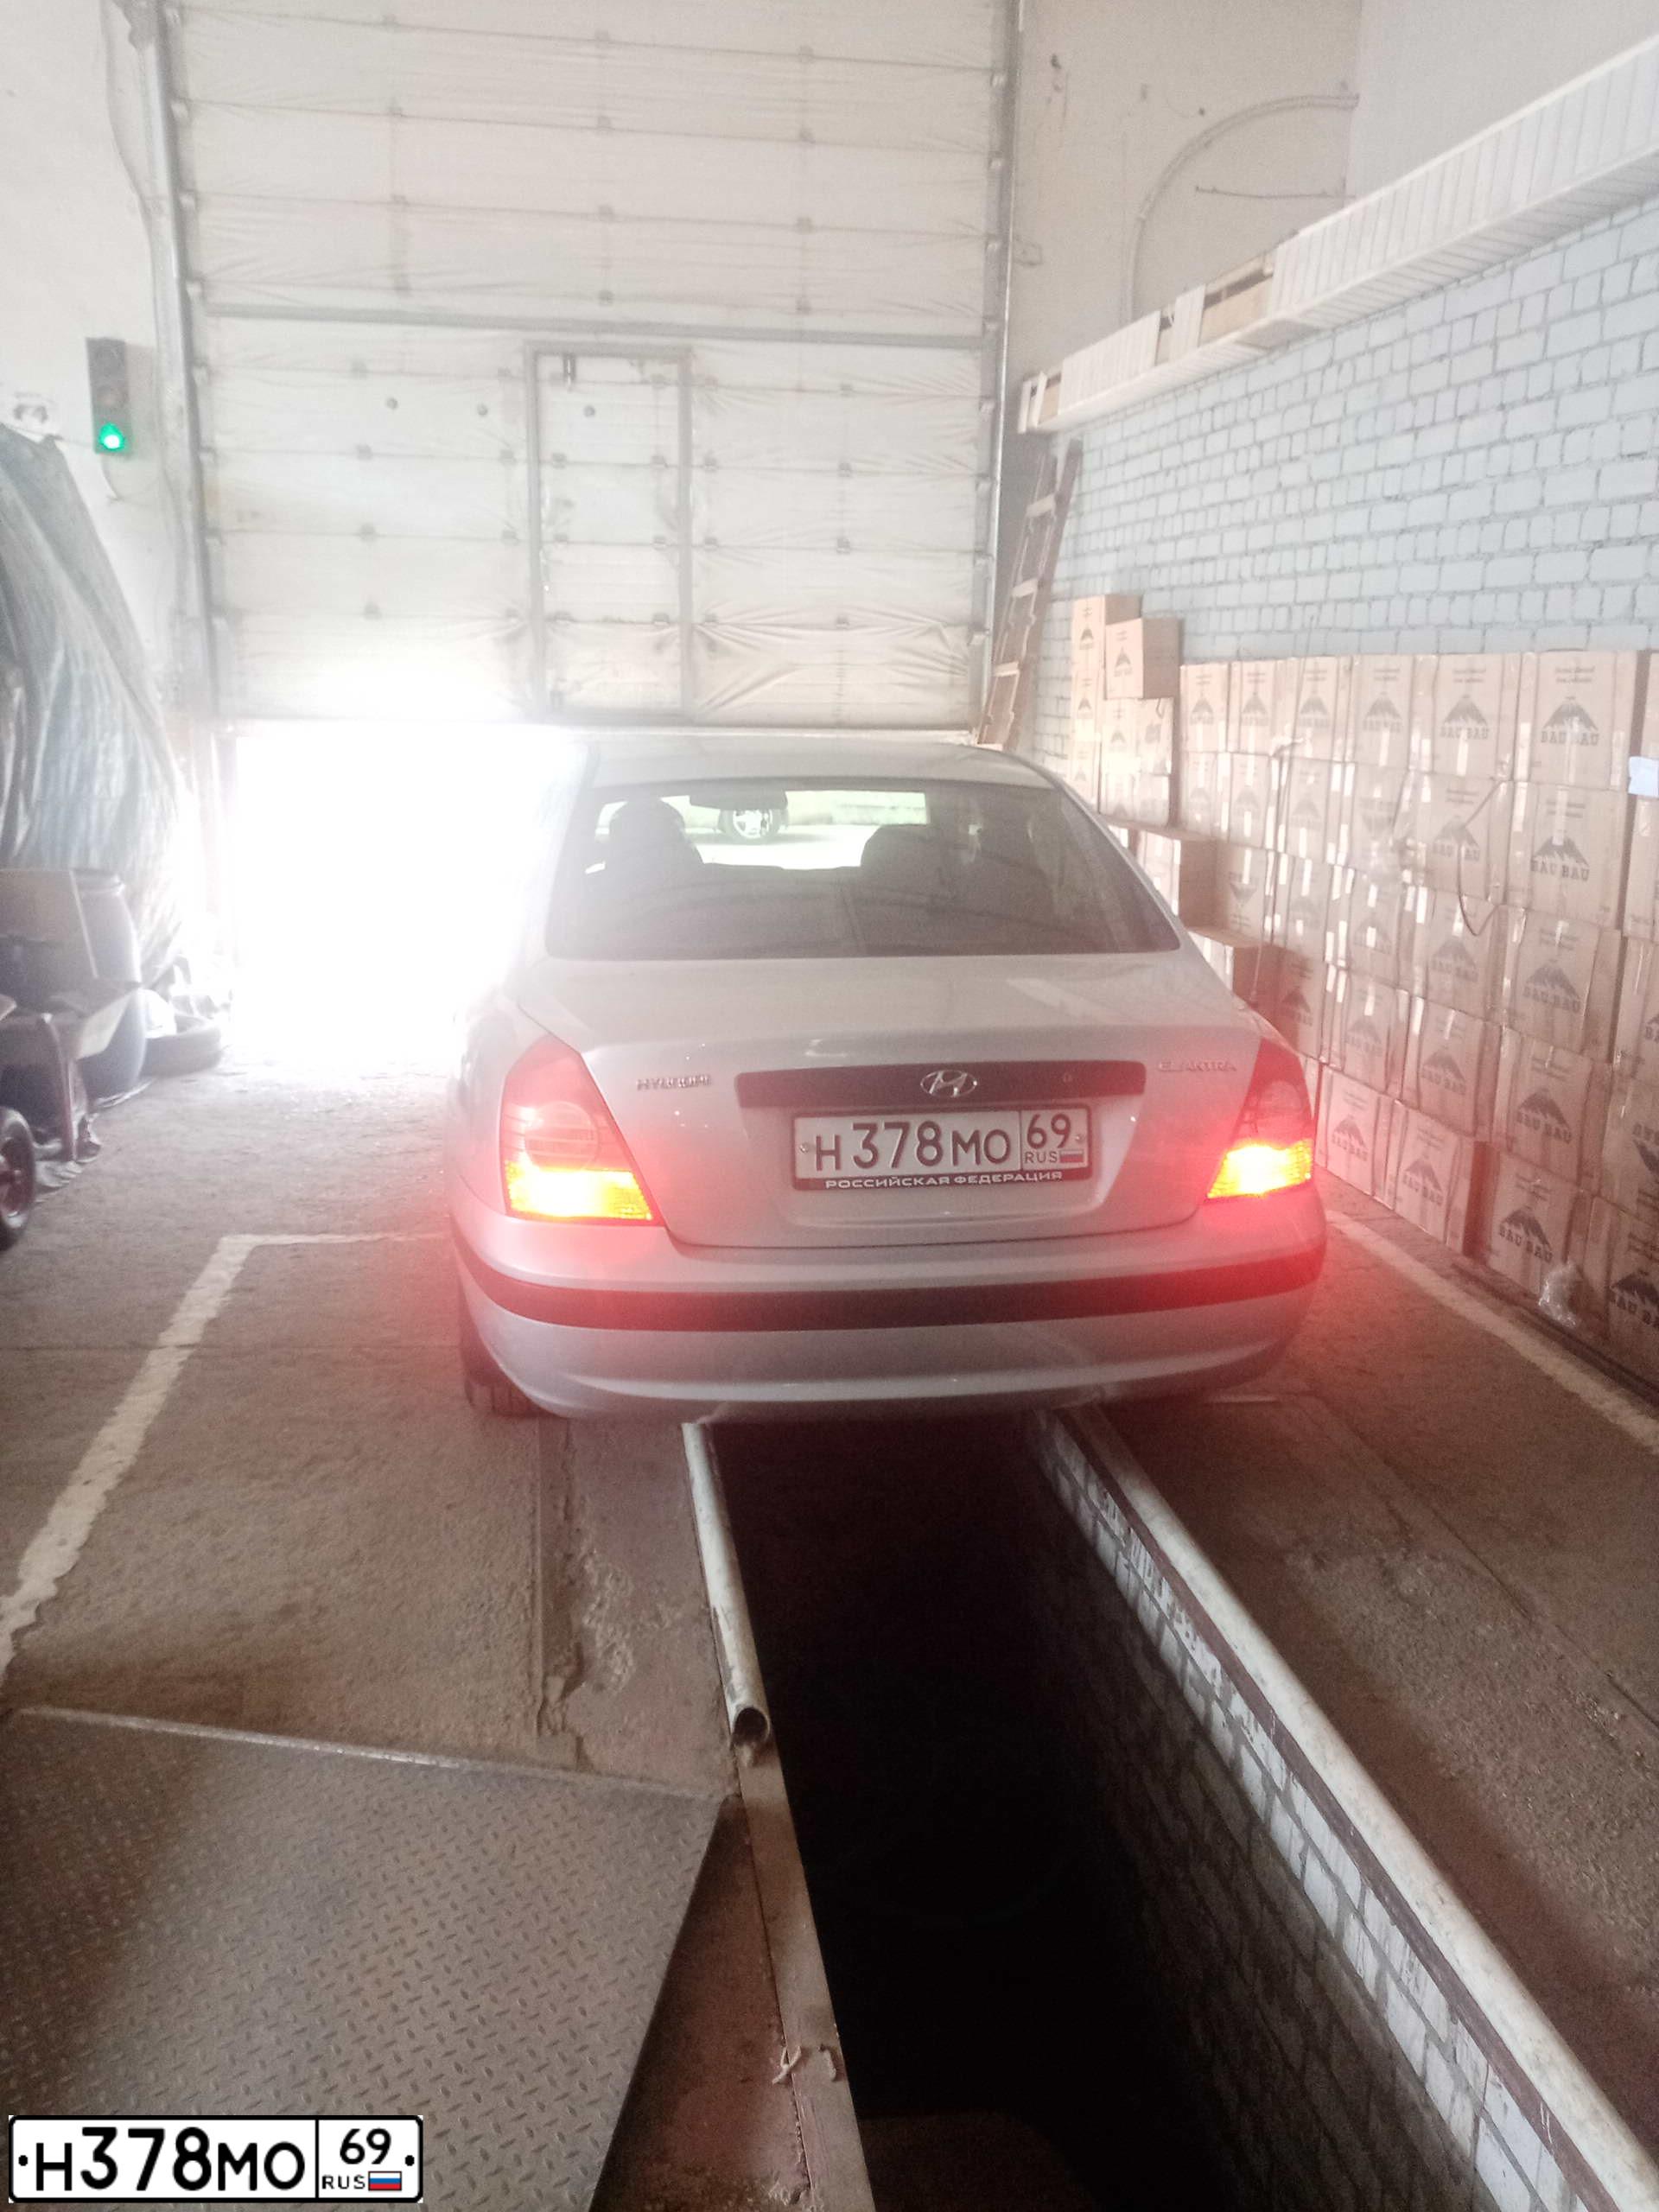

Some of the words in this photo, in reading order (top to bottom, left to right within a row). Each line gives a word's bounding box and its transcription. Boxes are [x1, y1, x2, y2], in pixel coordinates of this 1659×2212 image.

[1026, 1113, 1072, 1149] 69
[1024, 1150, 1058, 1164] RUS
[825, 1175, 950, 1190] РОССИЙСКАЯ
[954, 1170, 1063, 1185] ФЕДЕРАЦИЯ
